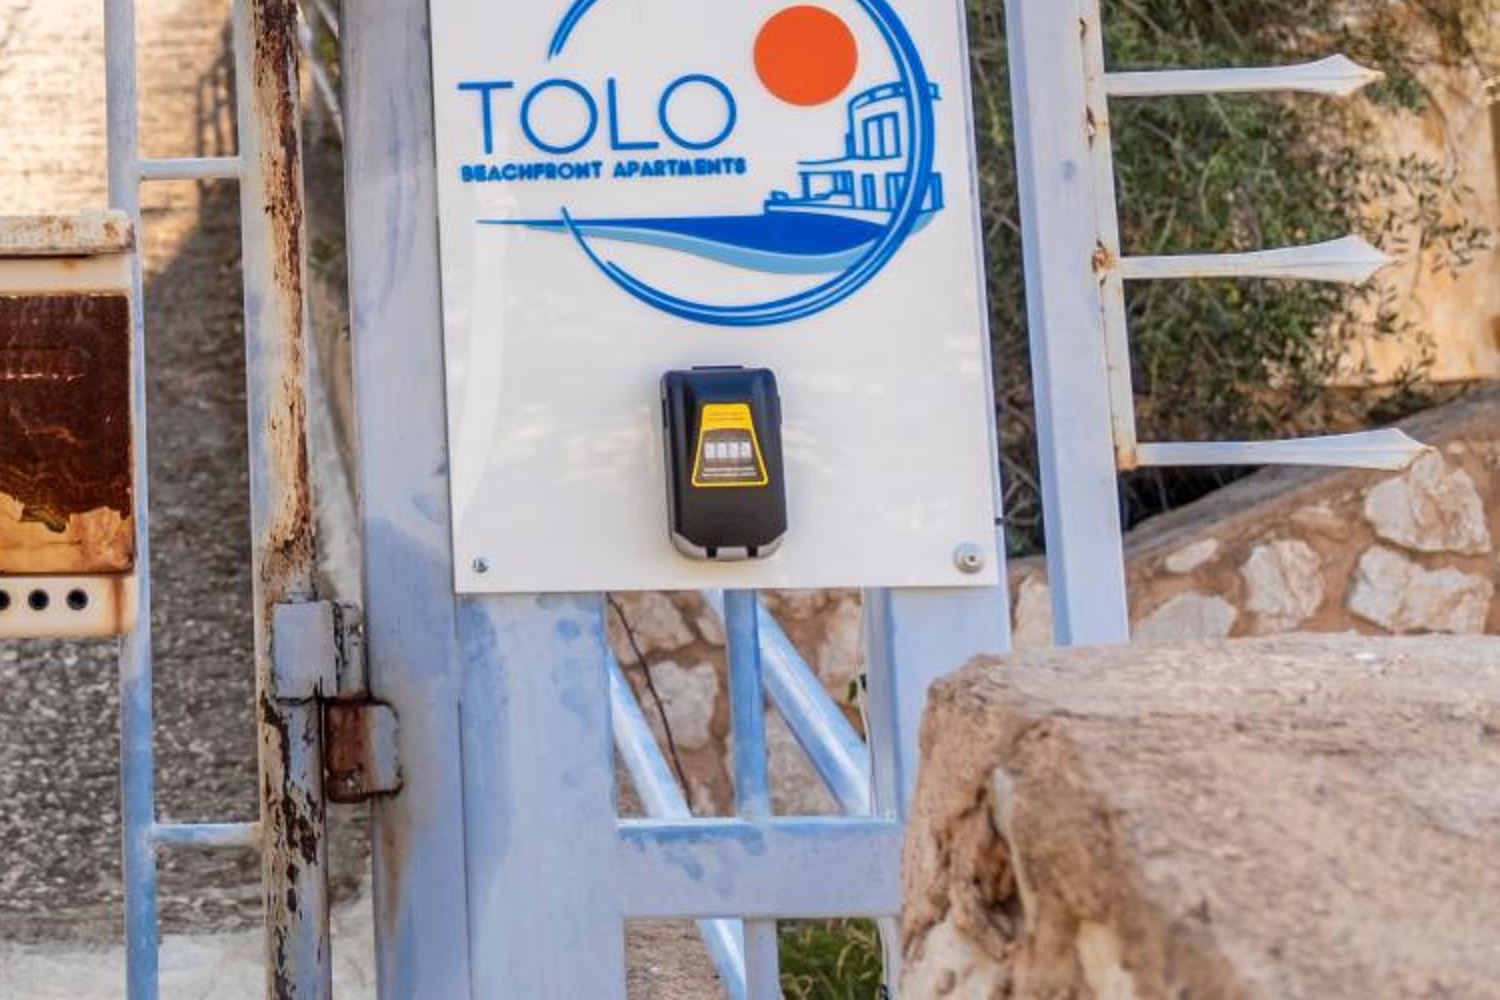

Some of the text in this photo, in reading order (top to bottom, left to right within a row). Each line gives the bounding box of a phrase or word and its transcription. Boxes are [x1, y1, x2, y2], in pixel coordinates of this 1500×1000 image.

[457, 73, 737, 155] TOLO
[461, 157, 747, 182] BEACHFRONT APARTMENTS
